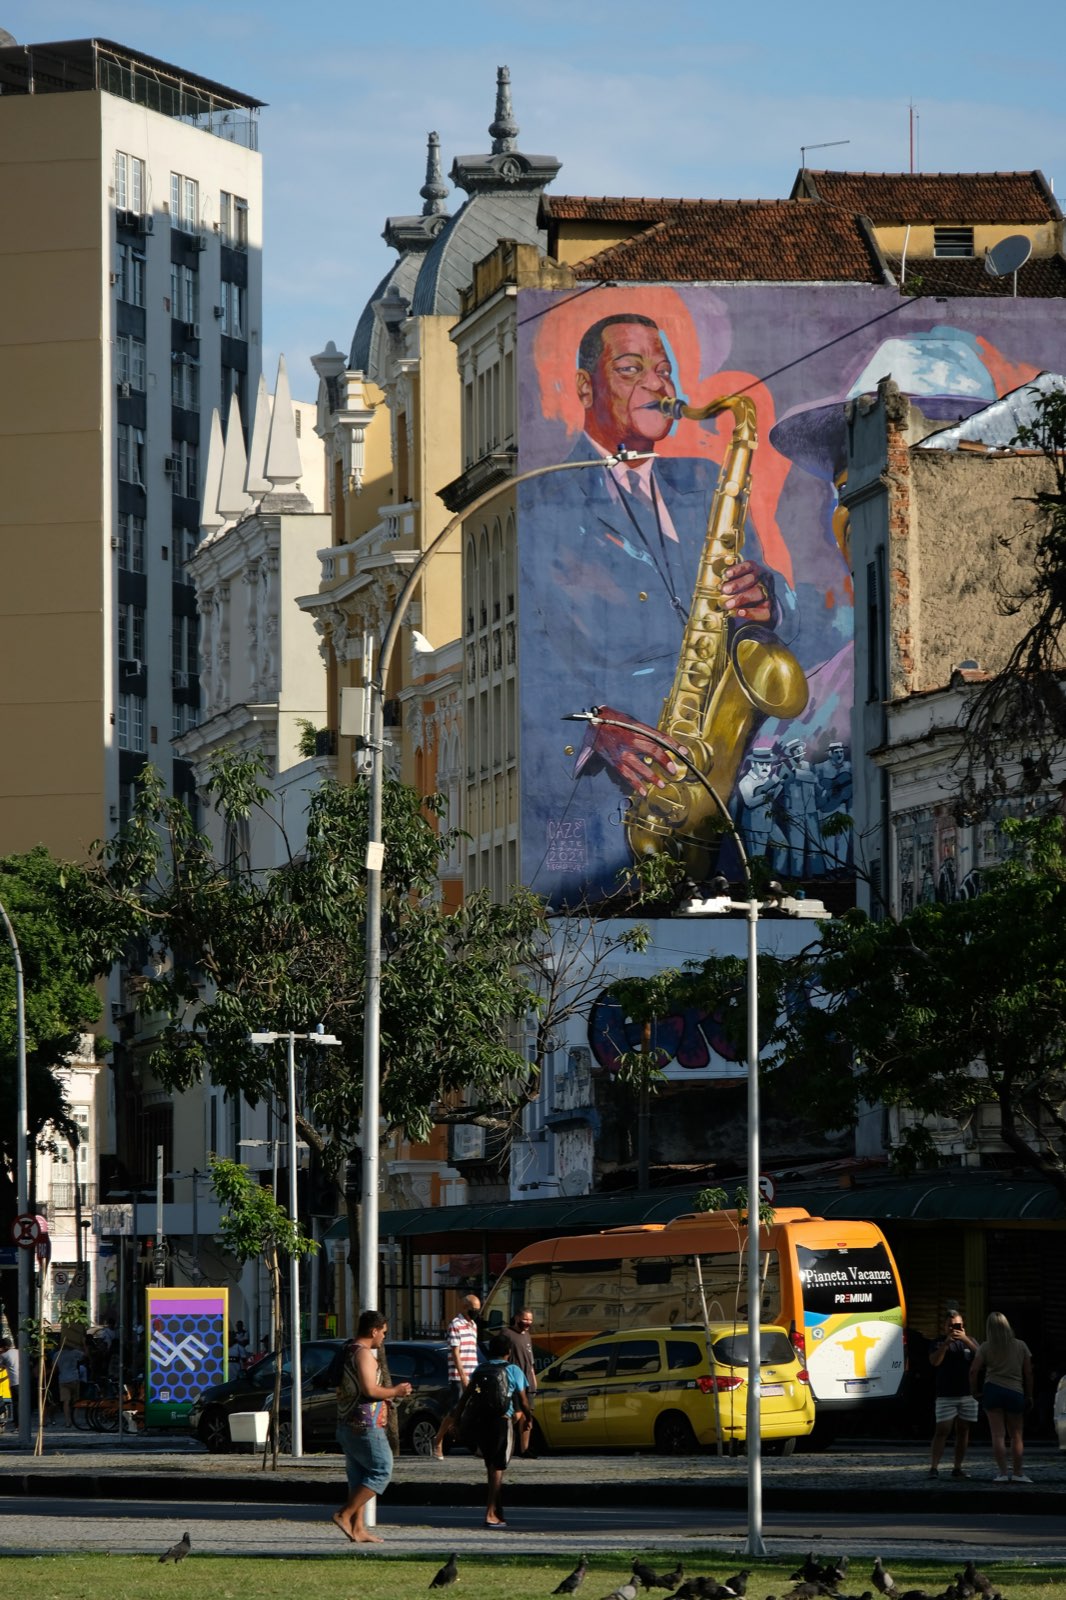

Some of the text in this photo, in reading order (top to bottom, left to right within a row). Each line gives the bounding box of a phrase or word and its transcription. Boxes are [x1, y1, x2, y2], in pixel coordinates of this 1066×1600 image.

[549, 850, 584, 862] 2021
[805, 1267, 891, 1282] Pianeta Vacanze
[835, 1293, 872, 1303] PREMIUM
